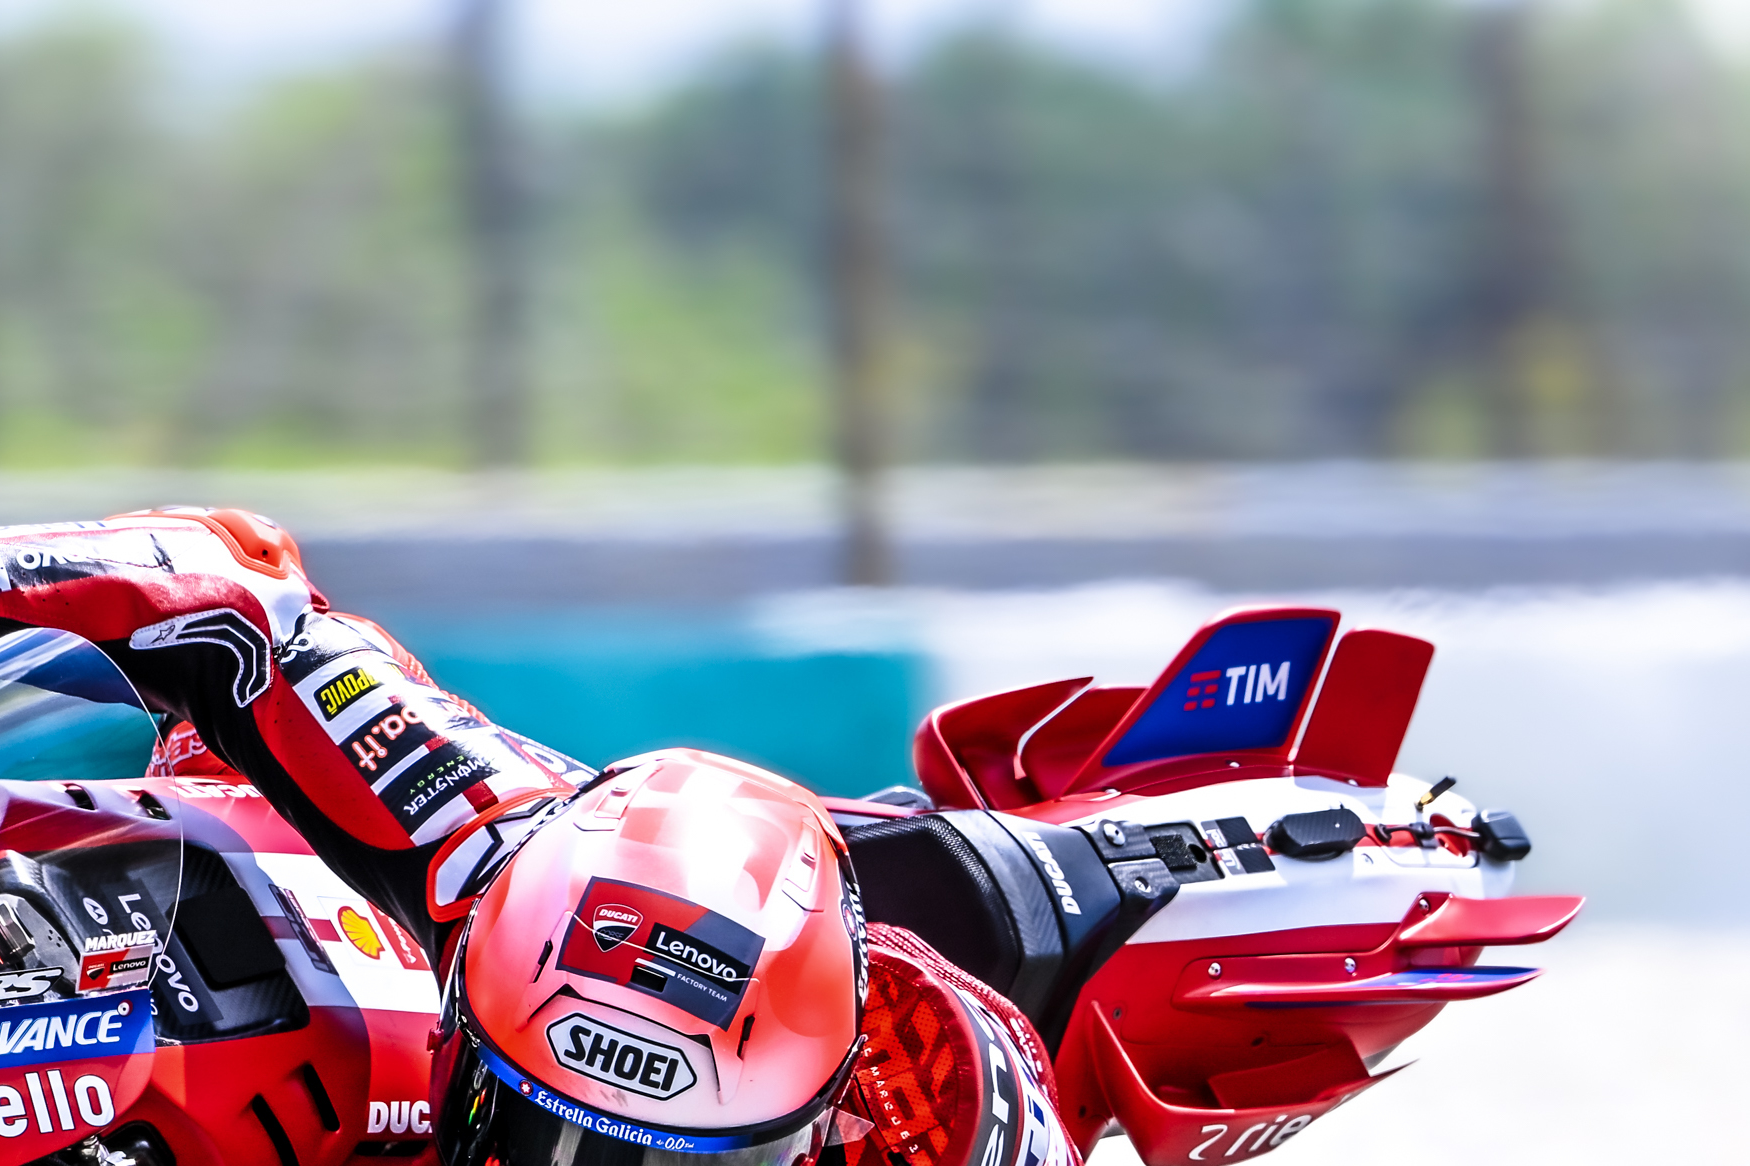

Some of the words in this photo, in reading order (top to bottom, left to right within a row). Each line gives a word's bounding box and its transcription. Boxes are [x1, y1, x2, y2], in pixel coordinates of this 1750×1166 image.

[1226, 662, 1290, 705] TIM
[168, 784, 264, 798] UCATI
[1021, 831, 1082, 915] DUCATI
[599, 908, 638, 923] DUCATI
[85, 930, 157, 952] MARQUEZ
[655, 931, 737, 982] Lenovo
[113, 960, 146, 972] Lenovo
[676, 973, 708, 992] FACTORY
[709, 988, 728, 1002] TEAM
[564, 1025, 679, 1092] SHOEI
[368, 1100, 433, 1134] DUC
[535, 1090, 592, 1128] Estrella
[596, 1118, 652, 1146] Galicia
